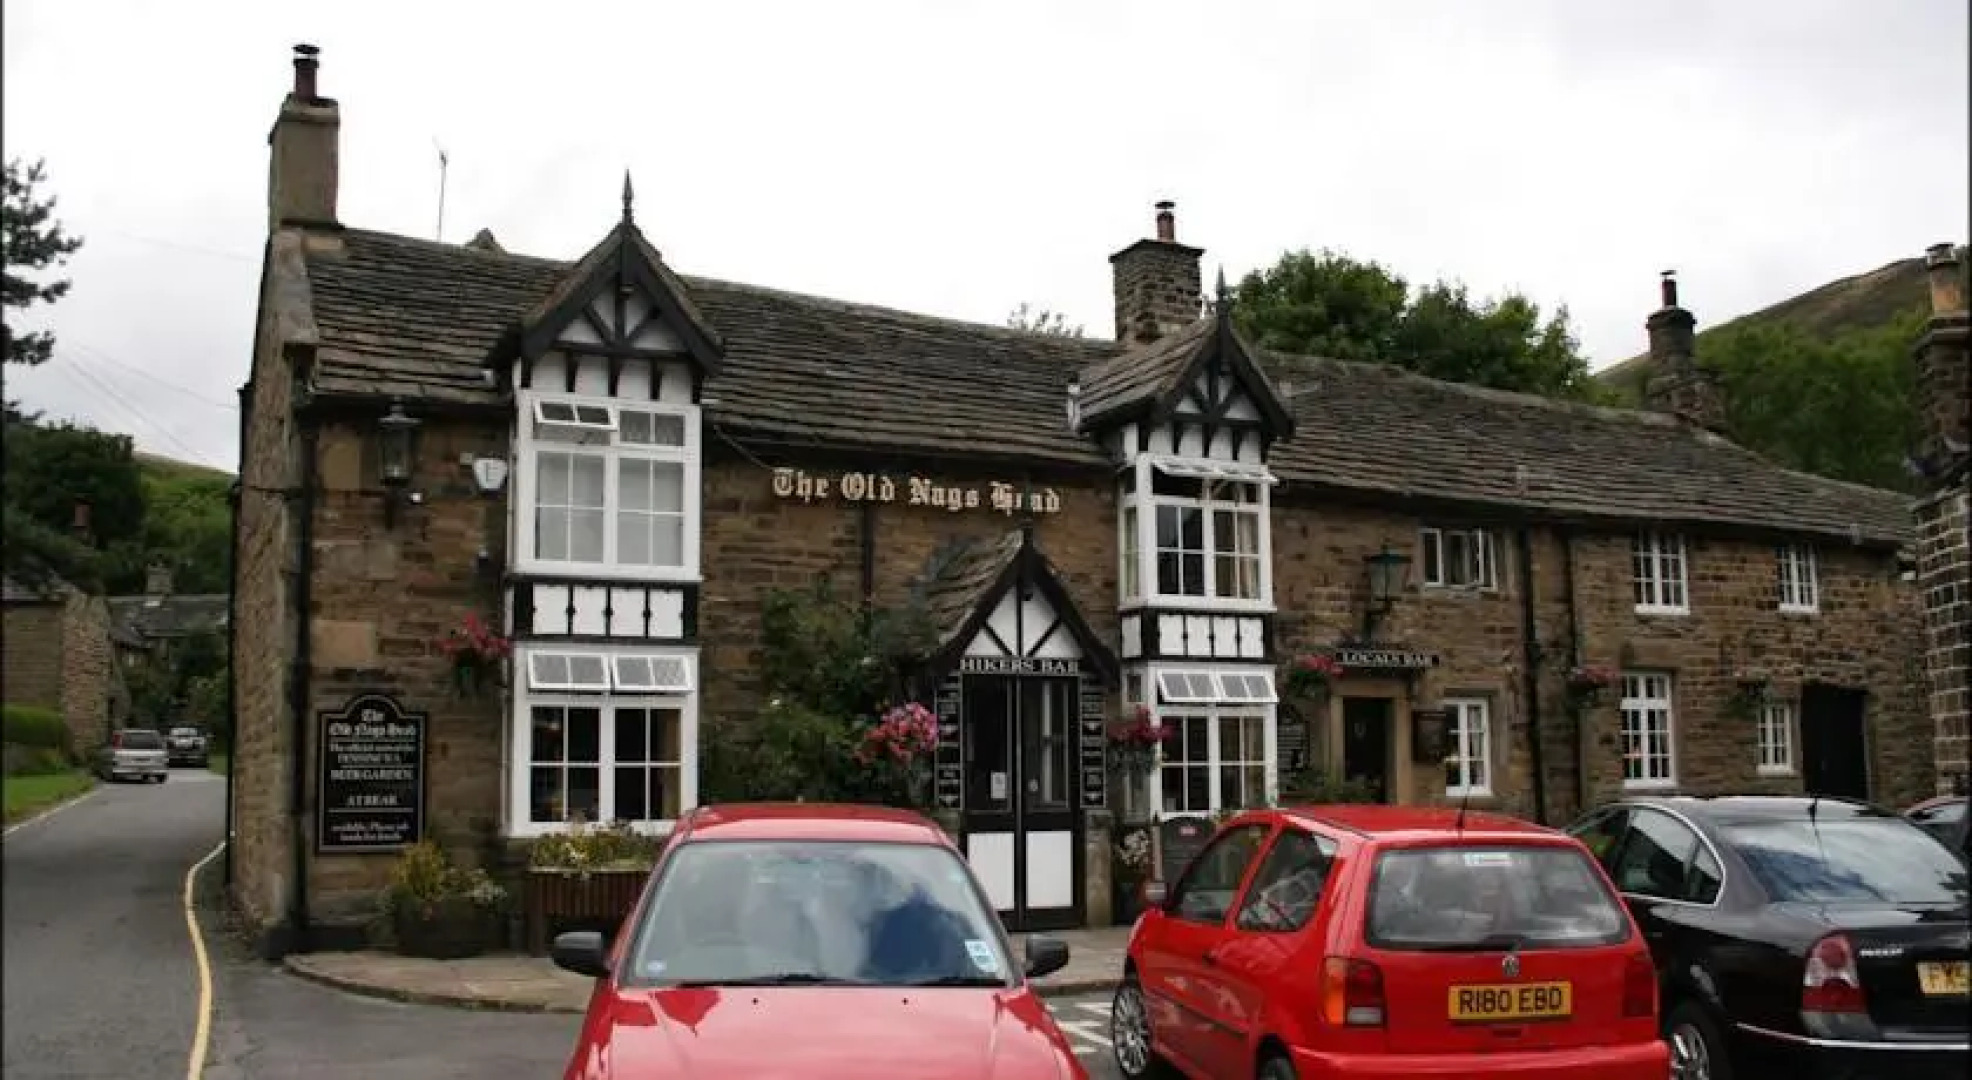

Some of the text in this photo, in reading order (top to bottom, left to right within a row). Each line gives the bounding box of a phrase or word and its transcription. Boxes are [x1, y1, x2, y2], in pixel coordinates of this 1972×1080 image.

[772, 467, 830, 503] The
[840, 471, 896, 501] Old
[907, 477, 980, 511] Nags
[960, 658, 1033, 672] HIKERS
[1458, 988, 1512, 1014] R180
